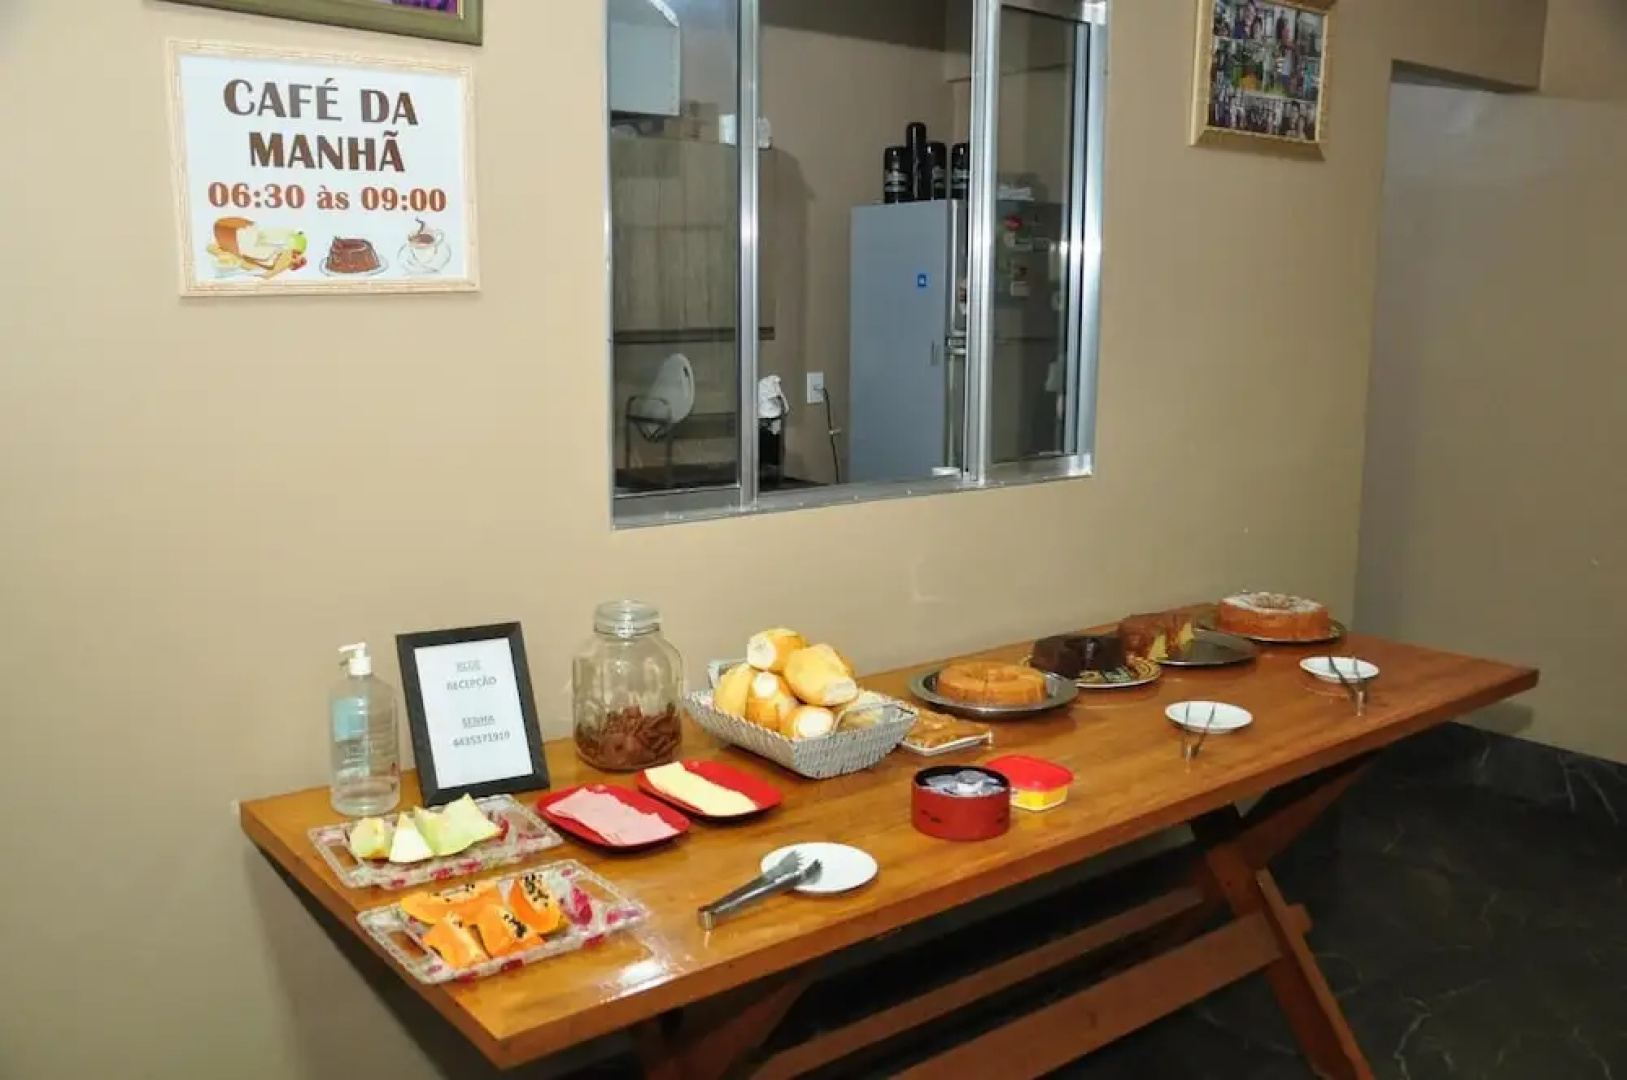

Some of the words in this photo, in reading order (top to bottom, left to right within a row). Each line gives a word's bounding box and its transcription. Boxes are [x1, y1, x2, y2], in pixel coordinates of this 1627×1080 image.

[223, 78, 343, 122] CAFÉ
[360, 88, 419, 126] DA
[249, 130, 405, 173] MANHÃ
[208, 181, 306, 209] 06:30
[316, 185, 350, 211] às
[360, 186, 447, 212] 09:00
[447, 675, 496, 690] RECEPÇÃO
[462, 715, 496, 729] SENHA
